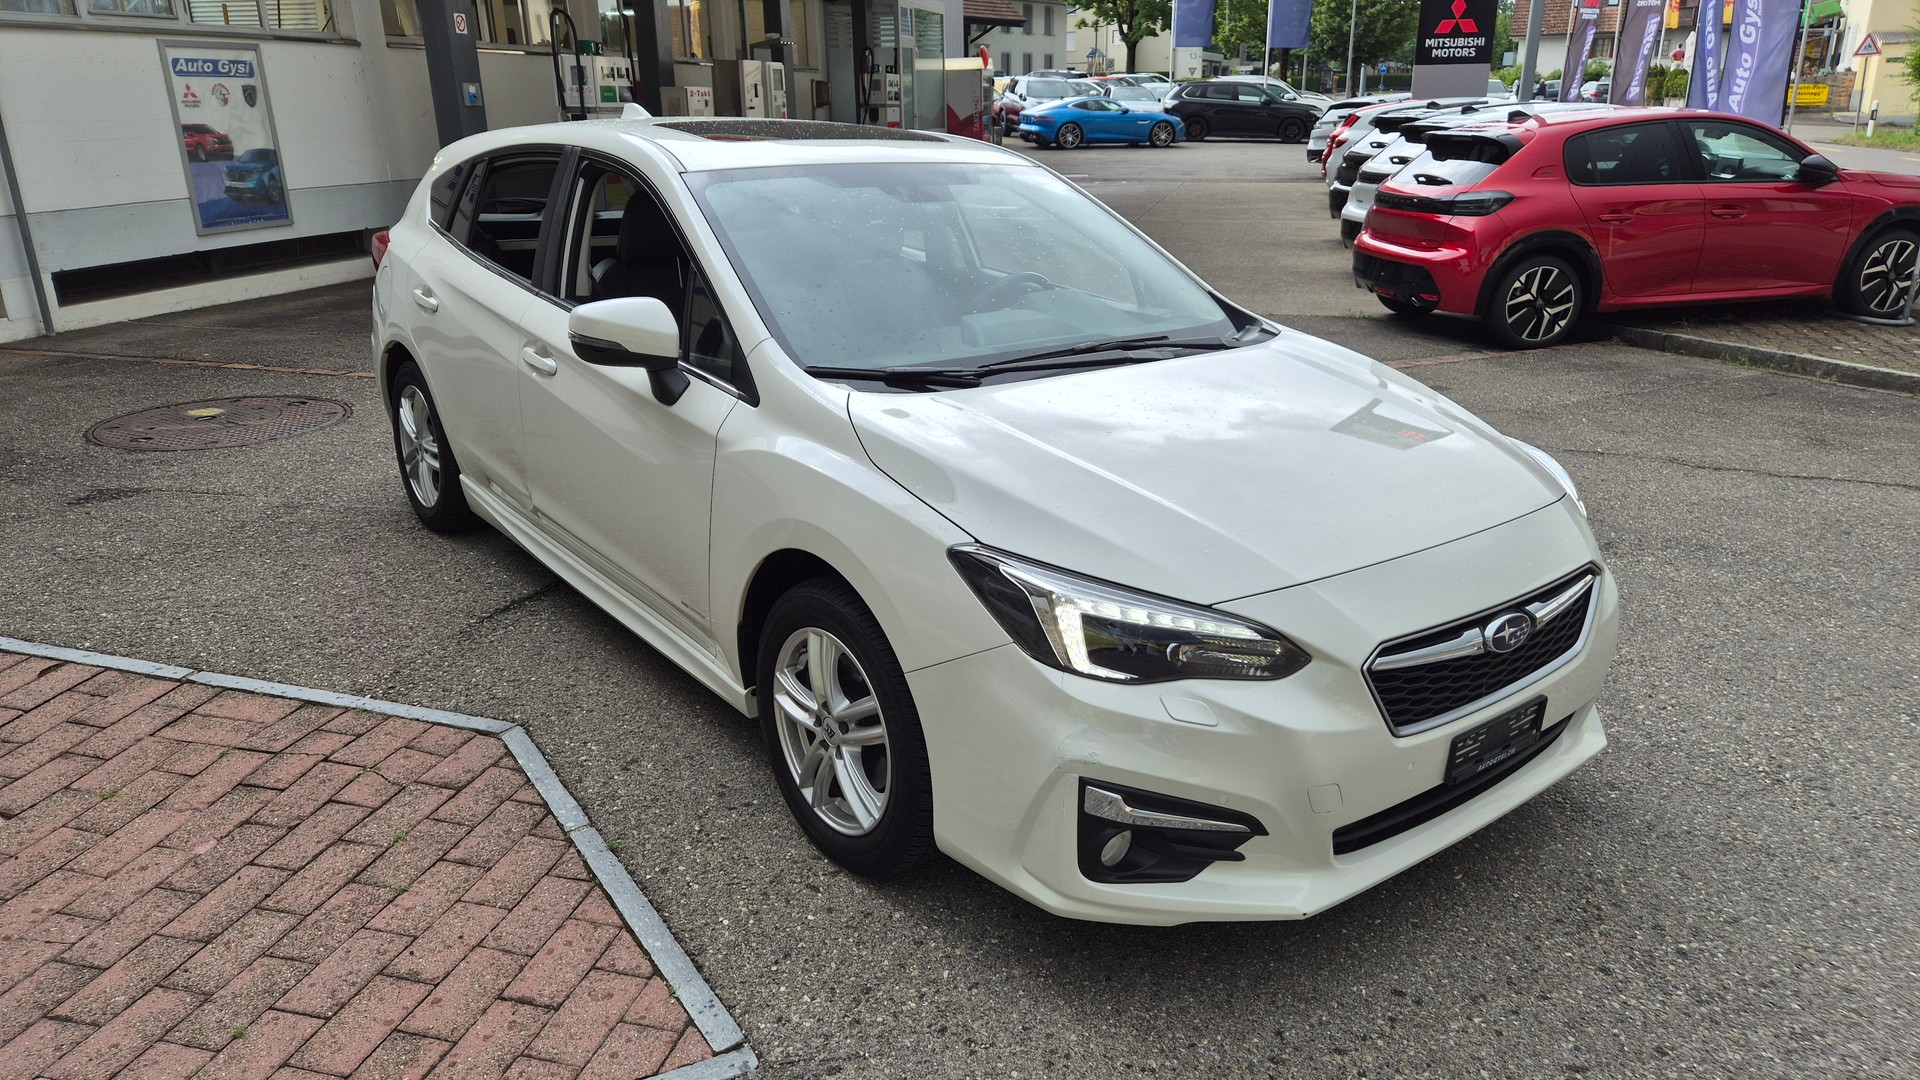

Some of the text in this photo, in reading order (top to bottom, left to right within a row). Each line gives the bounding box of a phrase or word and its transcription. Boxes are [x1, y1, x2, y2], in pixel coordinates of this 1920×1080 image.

[1425, 37, 1485, 48] MITSUBISHI
[1431, 48, 1476, 58] MOTORS
[175, 59, 250, 76] Auto Gysi
[1729, 52, 1752, 113] Auto
